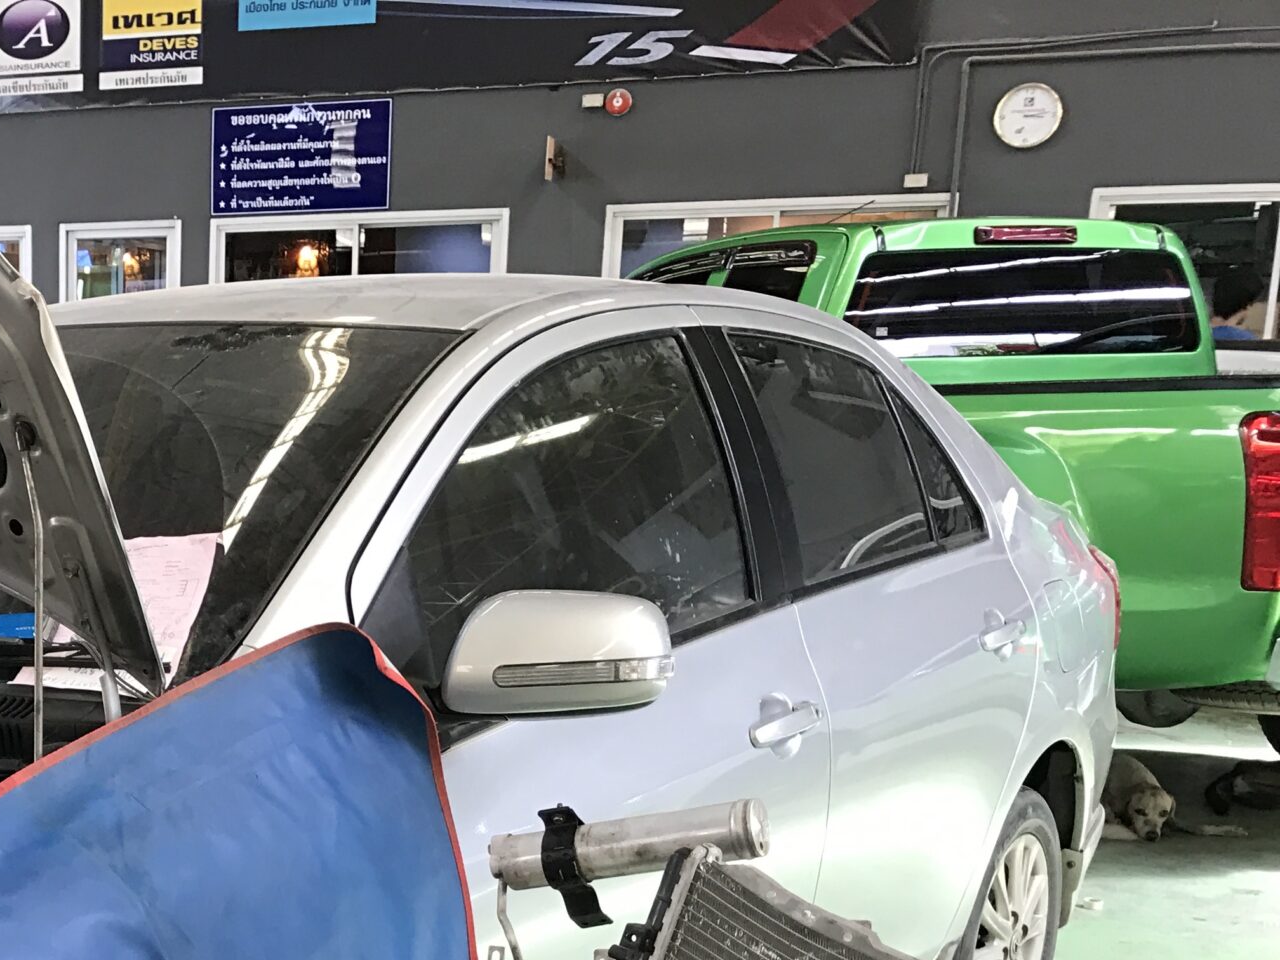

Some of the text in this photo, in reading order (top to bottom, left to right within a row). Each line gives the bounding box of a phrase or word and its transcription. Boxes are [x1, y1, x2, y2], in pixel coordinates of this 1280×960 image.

[139, 36, 199, 52] DEVES
[574, 29, 694, 67] 15
[130, 50, 198, 64] INSURANCE
